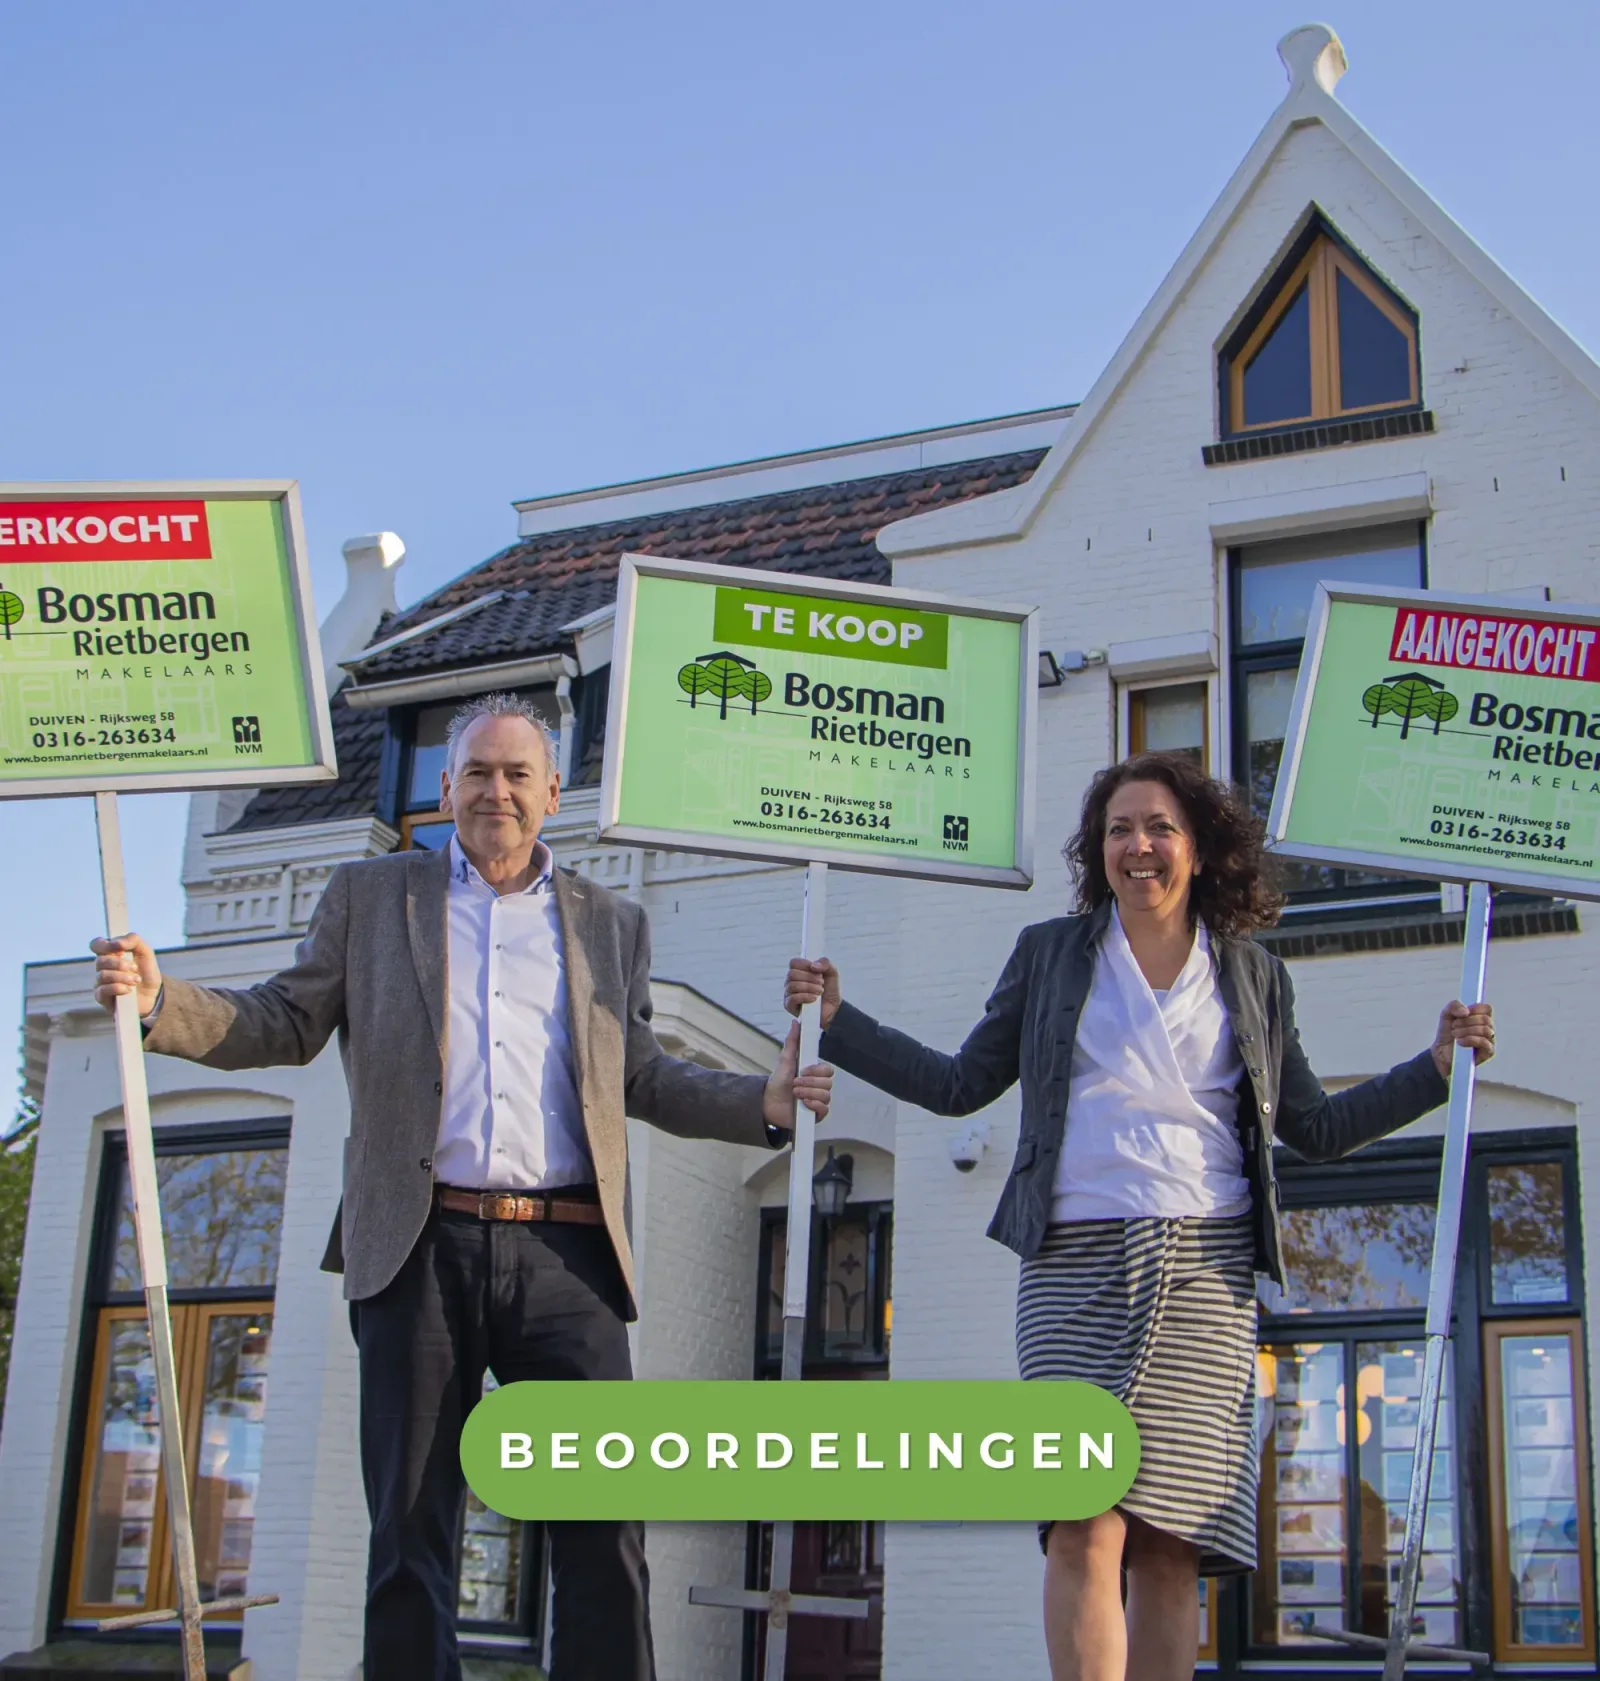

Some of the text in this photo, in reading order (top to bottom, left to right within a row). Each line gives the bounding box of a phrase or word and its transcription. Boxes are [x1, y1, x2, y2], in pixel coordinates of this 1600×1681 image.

[0, 515, 199, 545] ERKOCHT
[37, 587, 216, 624] Bosman
[743, 602, 924, 649] TE KOOP
[73, 626, 251, 661] Rietbergen
[1394, 613, 1596, 678] AANGEKOCHT
[76, 663, 254, 681] MAKELAARS
[784, 672, 945, 724] Bosman
[29, 714, 86, 727] DUIVEN
[99, 712, 157, 724] Rijksweg
[160, 711, 176, 722] 58
[32, 727, 177, 749] 0316-263634
[235, 744, 263, 755] NVM
[810, 715, 971, 760] Rietbergen
[4, 747, 209, 765] www.bosmanrietbergenmakelaars.nl
[809, 750, 970, 780] MAKELAARS
[760, 786, 811, 801] DUIVEN
[823, 793, 876, 810] Rijksweg
[878, 799, 893, 811] 58
[760, 801, 892, 831] 0316-263634
[1432, 804, 1486, 821] DUIVEN
[1498, 812, 1553, 831] Rijksweg
[1555, 820, 1572, 832] 58
[732, 818, 919, 847] www.bosmanrietbergenmakelaars.nl
[942, 840, 969, 852] NVM
[1430, 819, 1567, 851] 0316-263634
[1399, 836, 1594, 868] www.bosmanrietbergenmakelaars.nl
